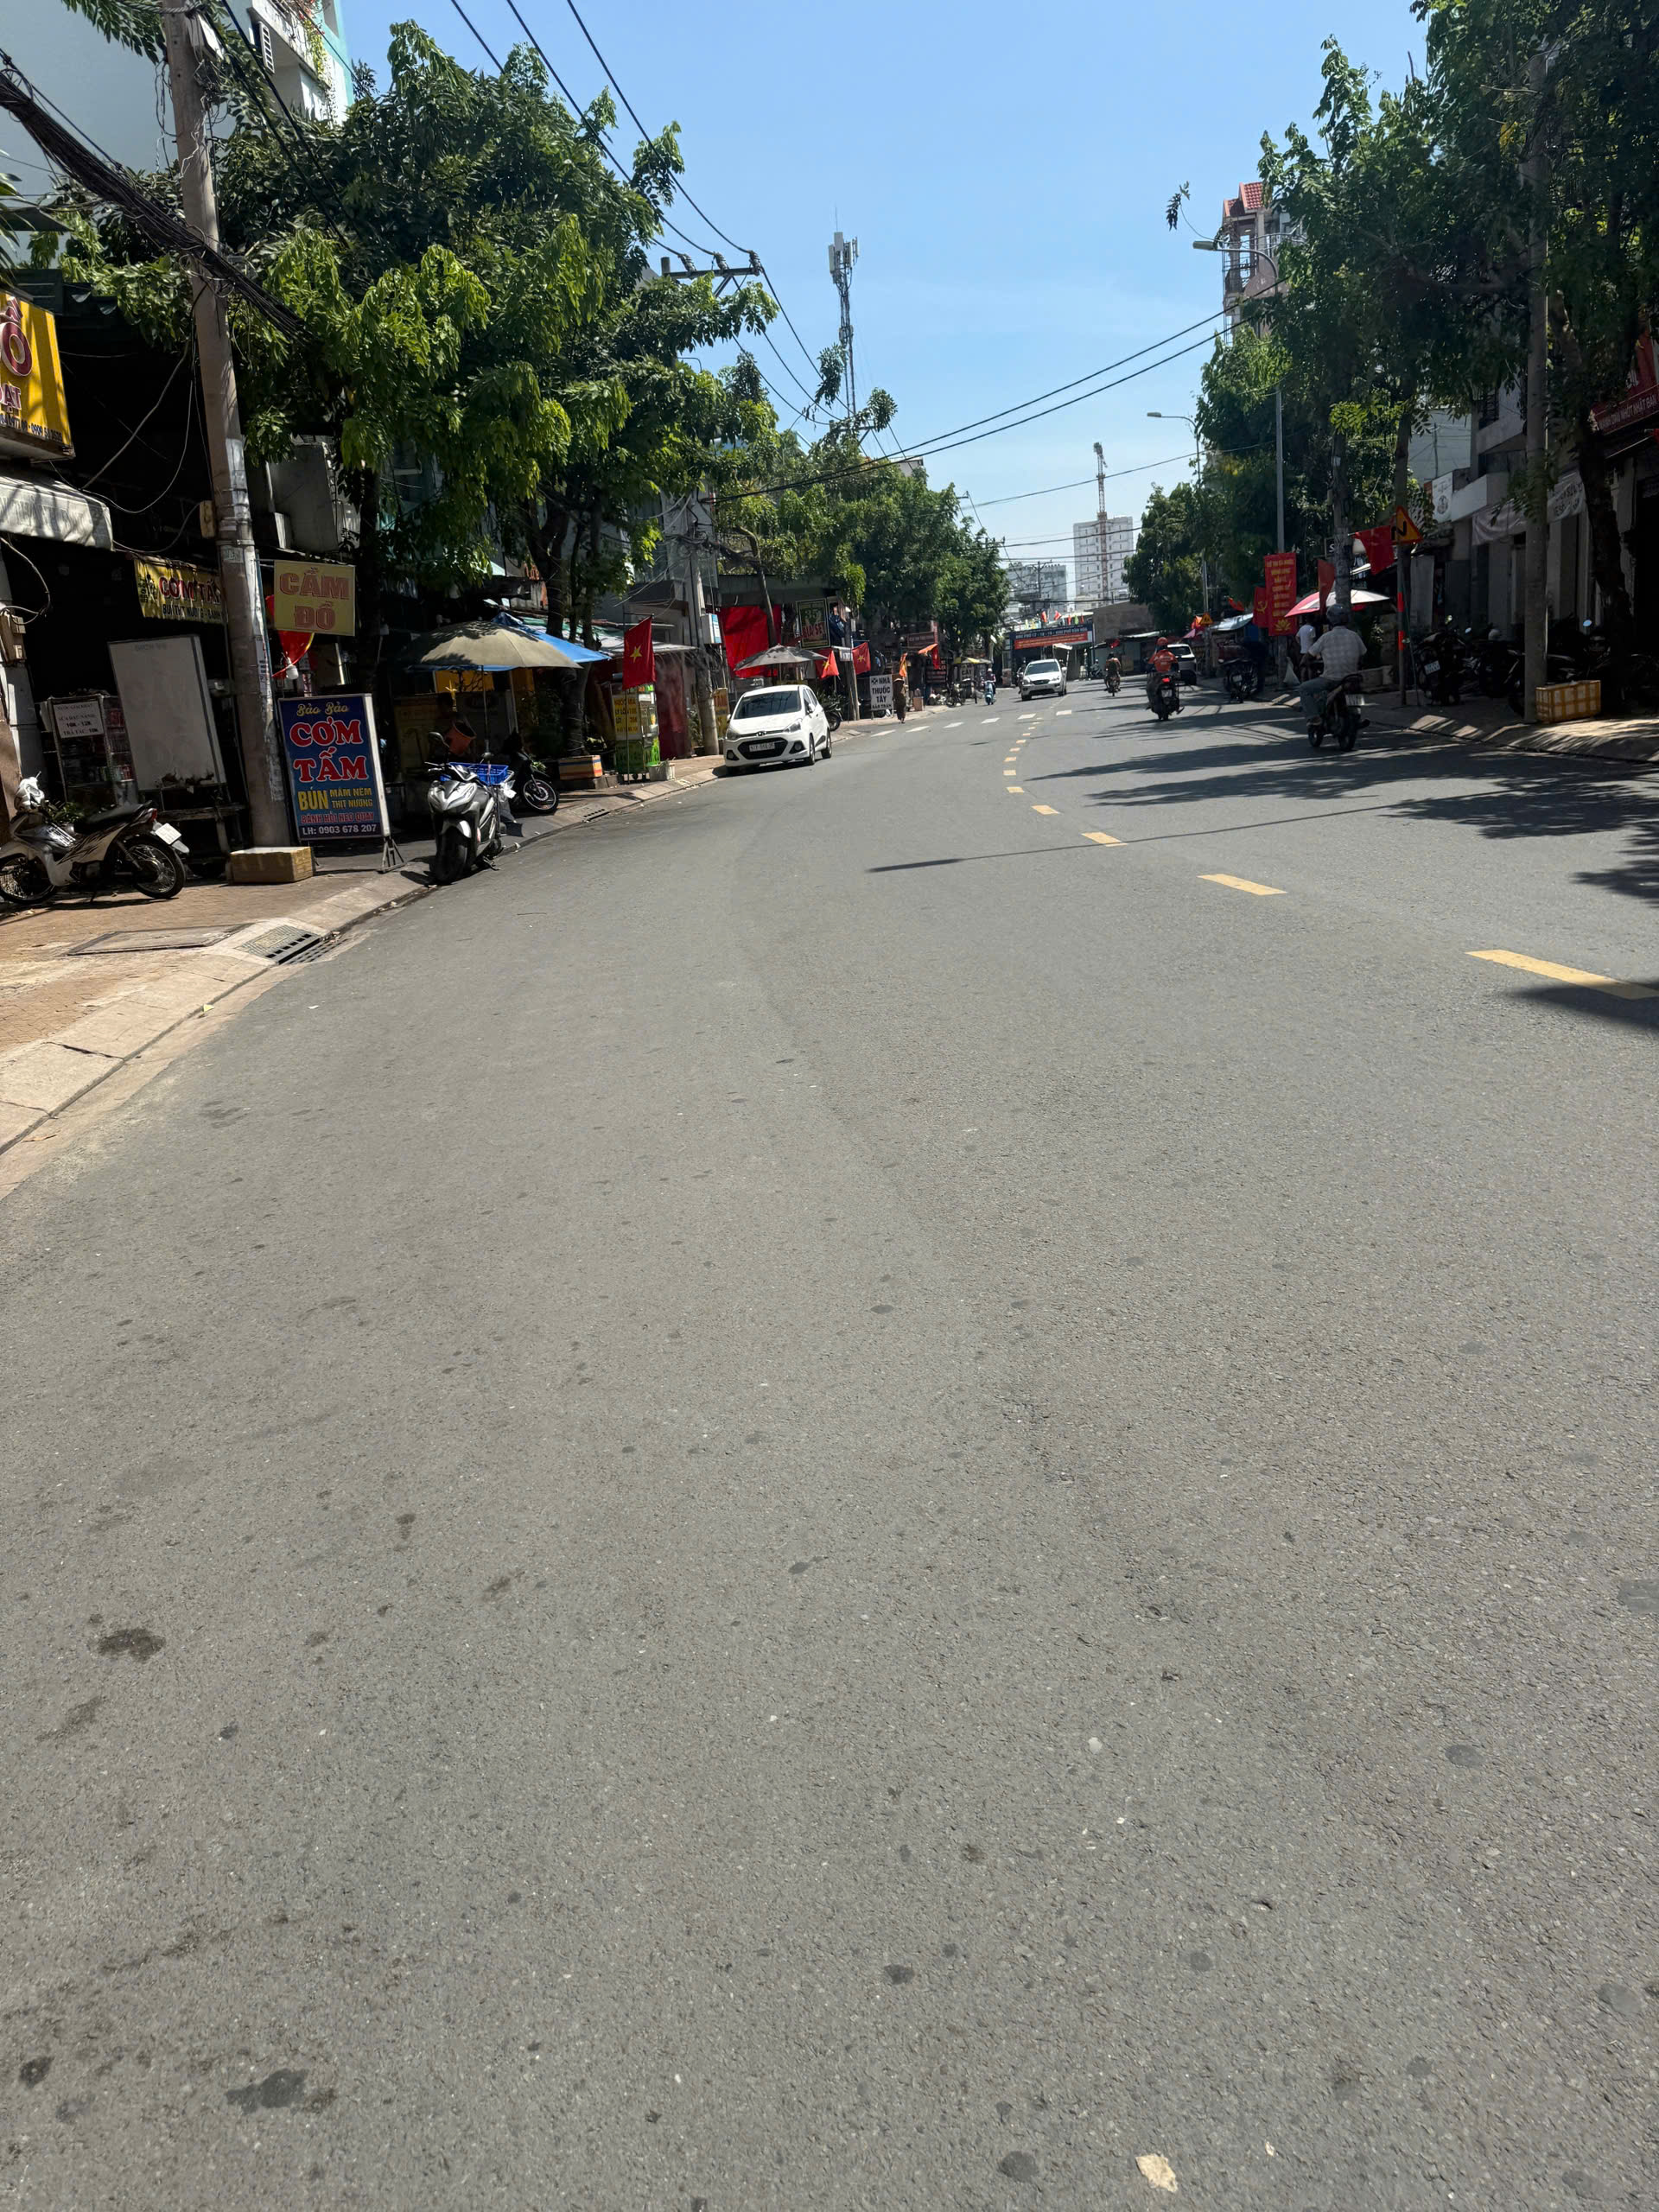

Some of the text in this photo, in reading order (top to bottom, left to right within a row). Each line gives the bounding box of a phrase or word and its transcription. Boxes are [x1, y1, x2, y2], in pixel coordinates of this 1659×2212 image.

[280, 567, 349, 600] CẦM
[294, 601, 335, 630] ĐỒ
[289, 716, 363, 747] CƠM
[293, 746, 369, 782] TẤM
[297, 786, 328, 810] BÚN
[302, 823, 377, 836] LH: 0903 678 207
